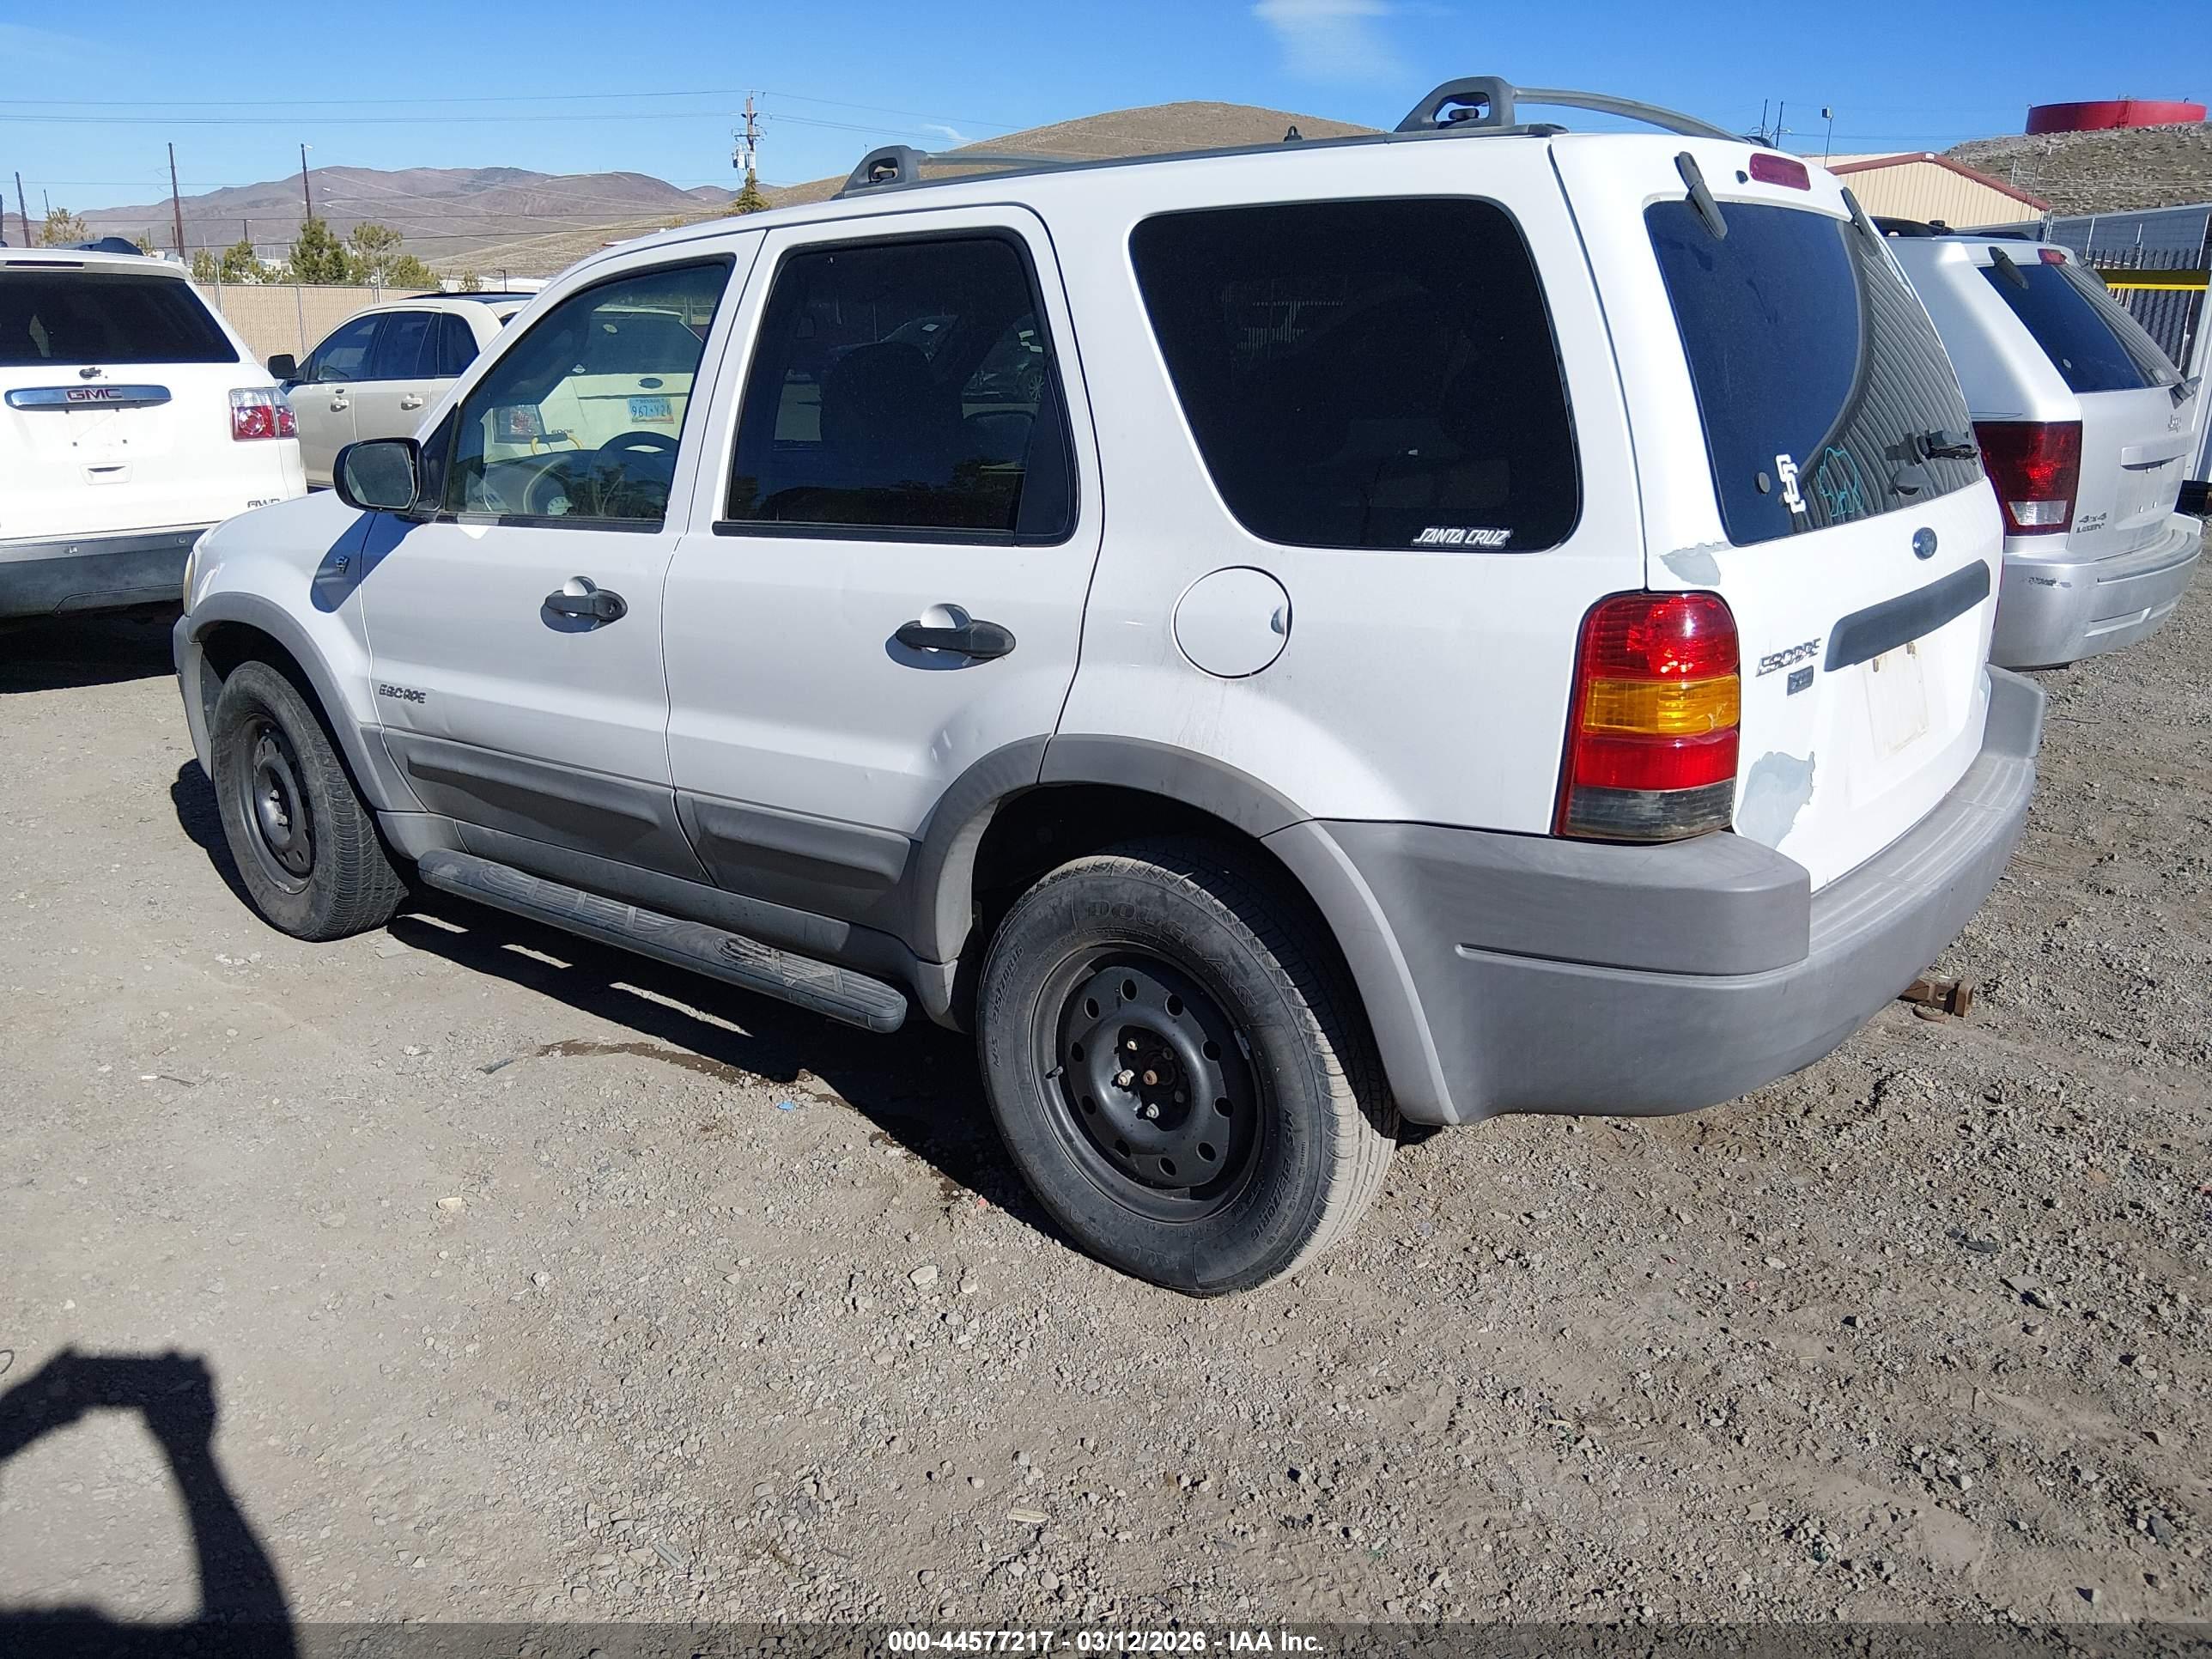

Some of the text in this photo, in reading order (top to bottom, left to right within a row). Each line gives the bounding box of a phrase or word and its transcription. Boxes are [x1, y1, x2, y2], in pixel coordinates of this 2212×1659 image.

[66, 388, 123, 401] GMC
[1413, 527, 1511, 546] SANTA CRUZ
[379, 684, 427, 704] ESCAPE
